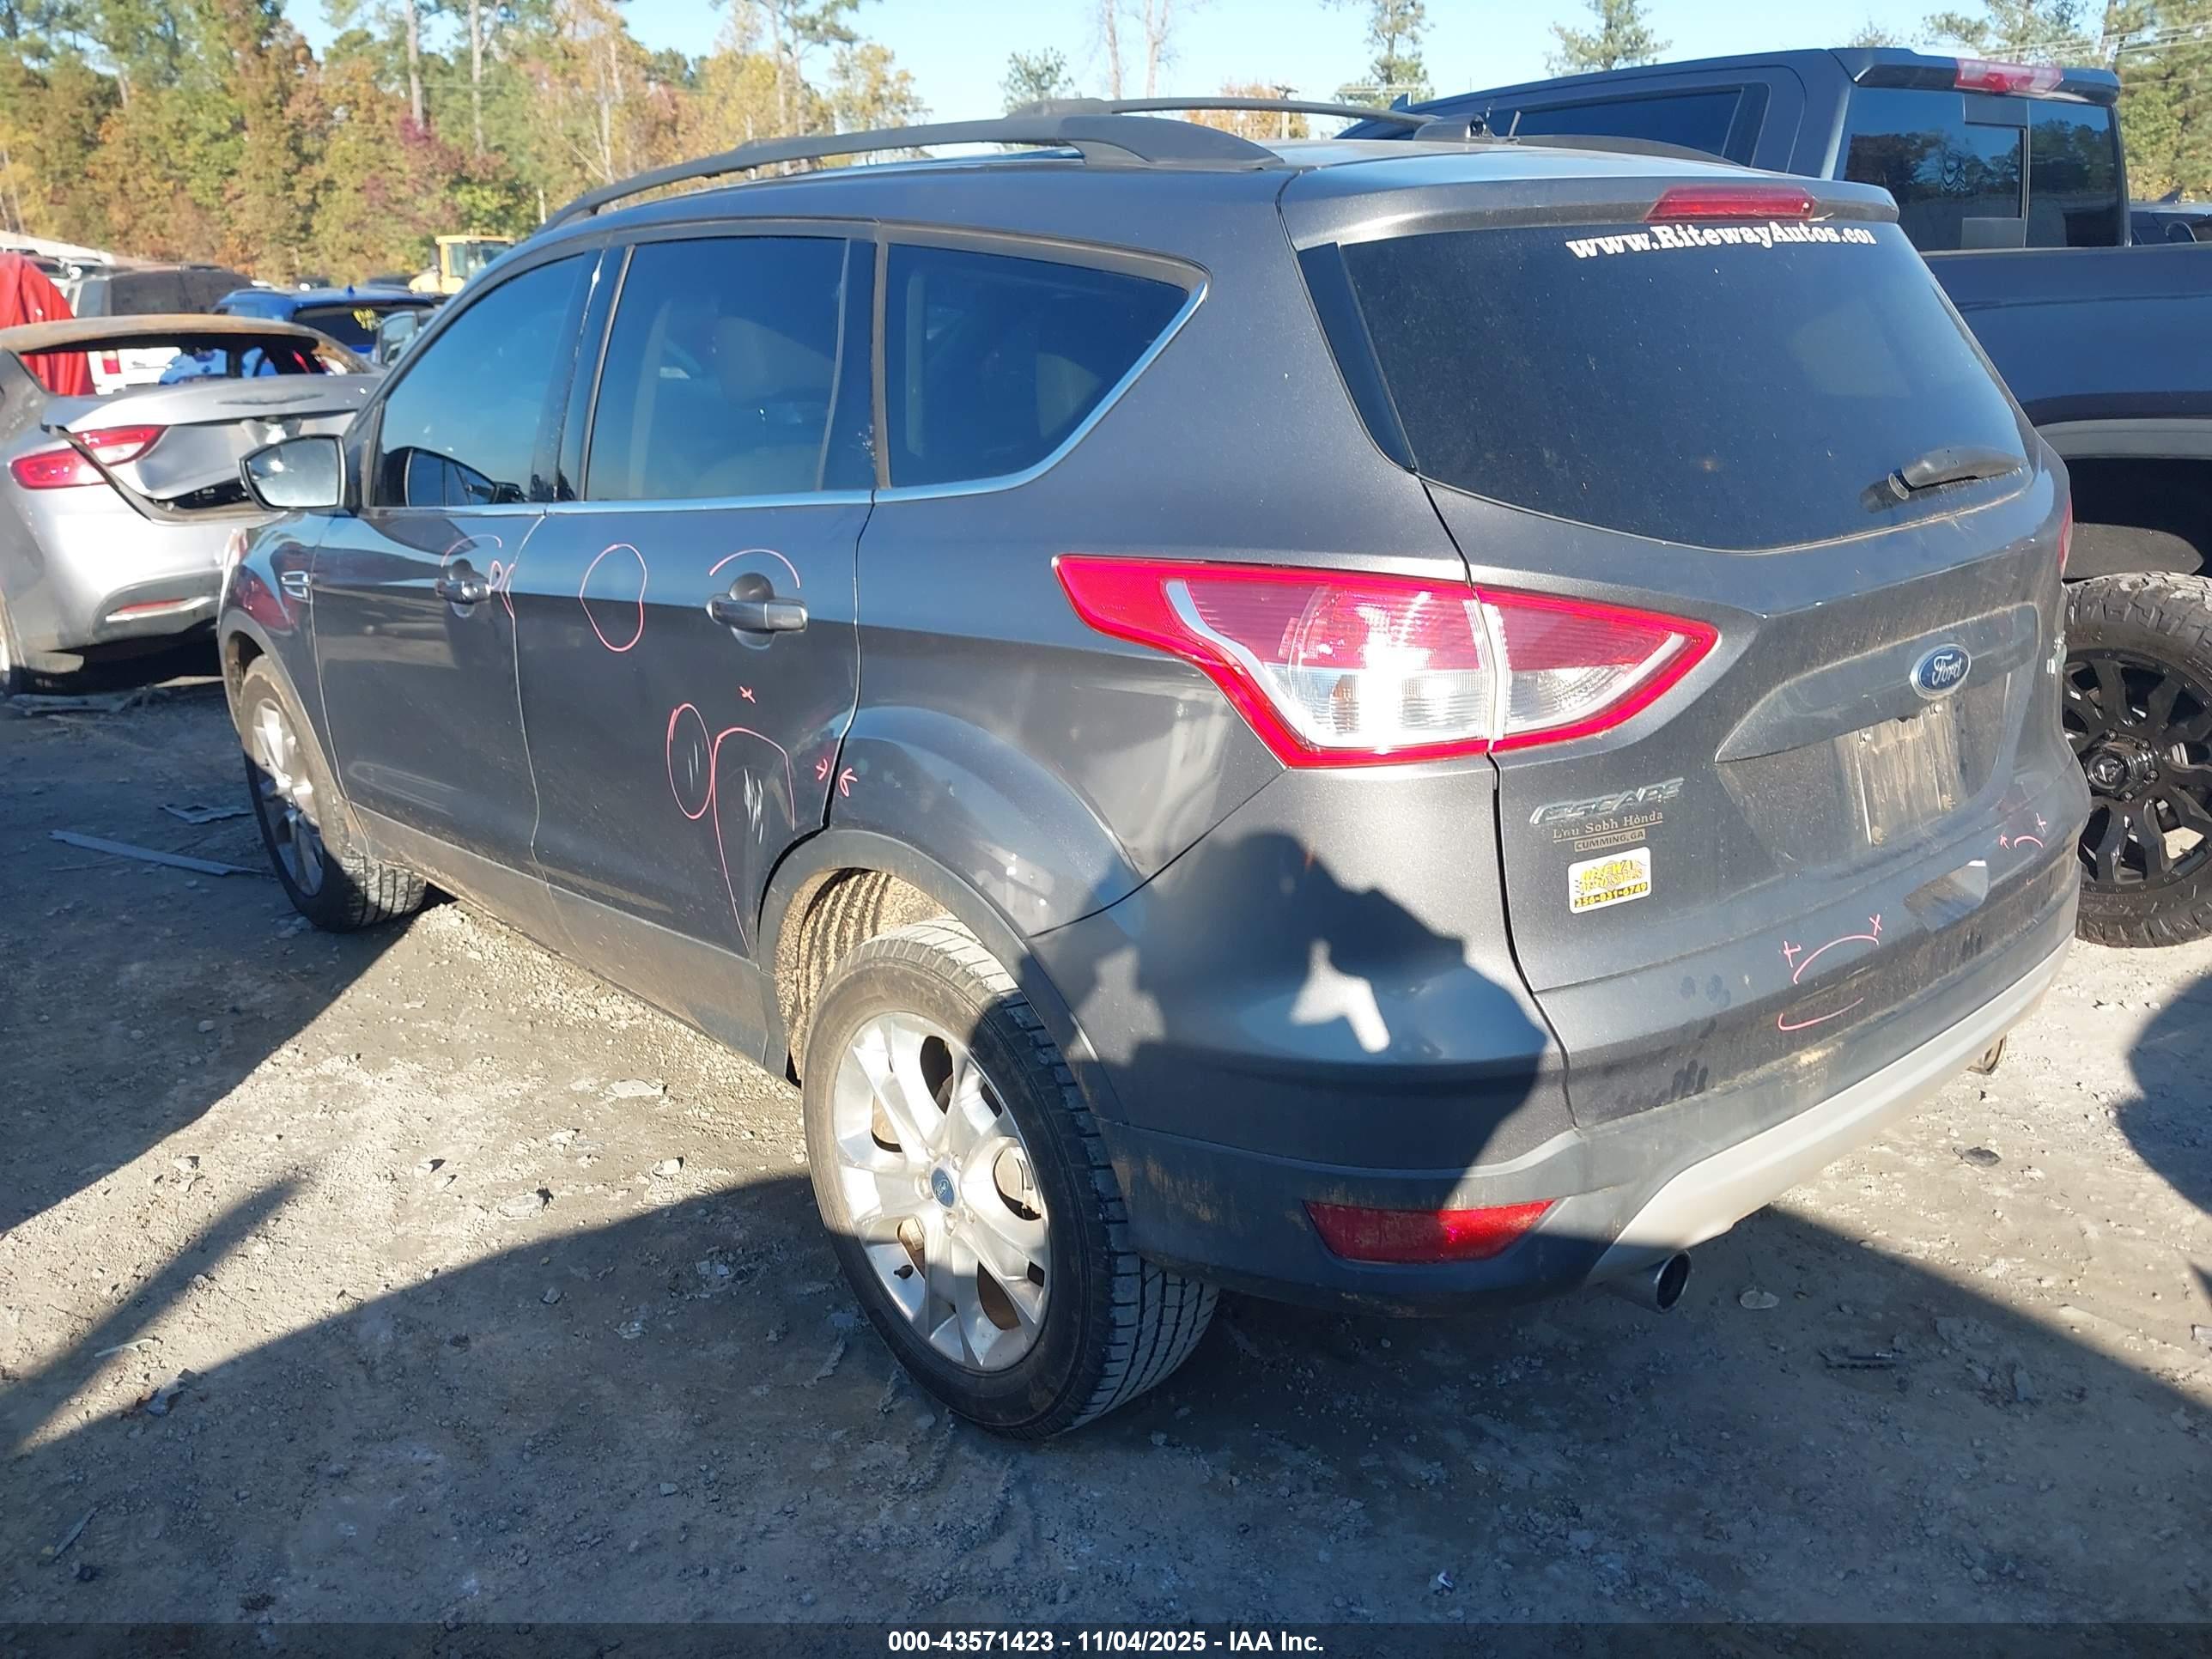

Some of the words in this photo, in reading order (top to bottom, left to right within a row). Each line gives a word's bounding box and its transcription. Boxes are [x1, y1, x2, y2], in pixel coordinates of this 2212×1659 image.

[1931, 653, 1963, 686] Ford
[1529, 777, 1685, 824] ESCAPE
[1584, 819, 1619, 834] Sobh
[1623, 810, 1663, 827] Honda
